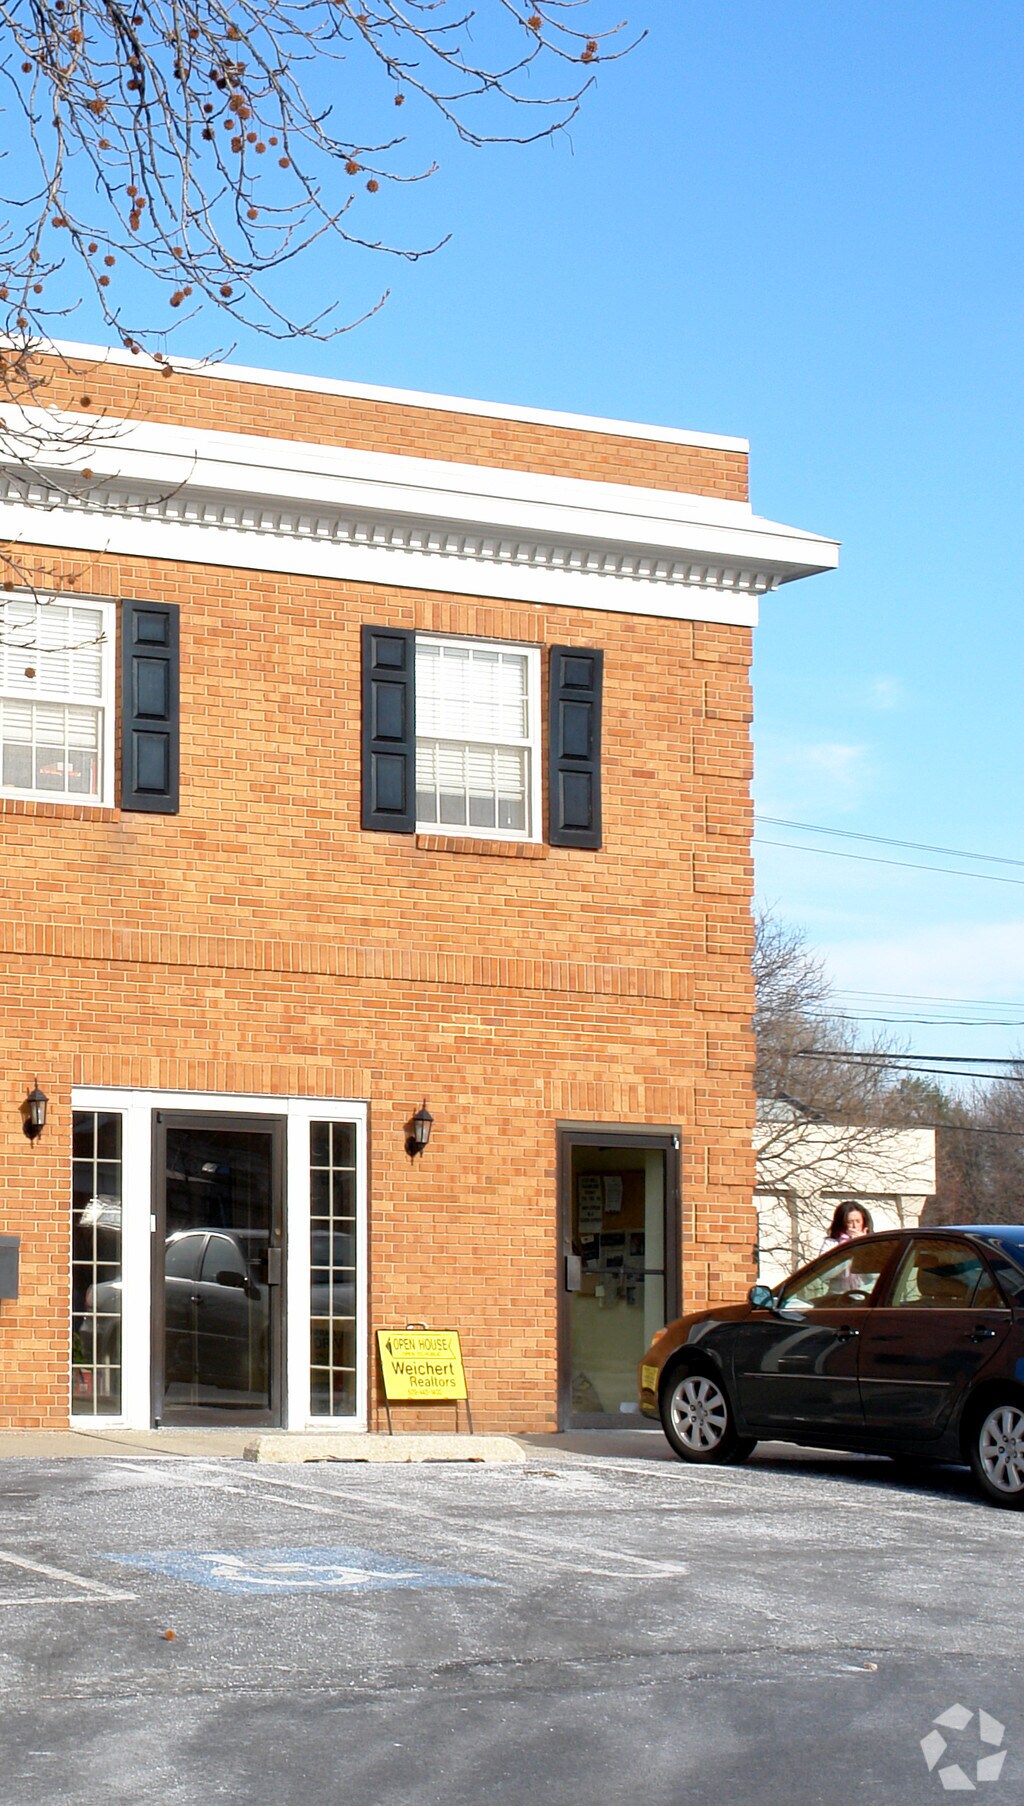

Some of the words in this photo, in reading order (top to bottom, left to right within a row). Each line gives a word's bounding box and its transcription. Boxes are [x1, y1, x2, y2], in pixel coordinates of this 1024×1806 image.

[393, 1338, 416, 1350] OPEN
[418, 1338, 448, 1351] HOUSE
[391, 1361, 455, 1375] Weichert
[410, 1376, 456, 1387] Realtors
